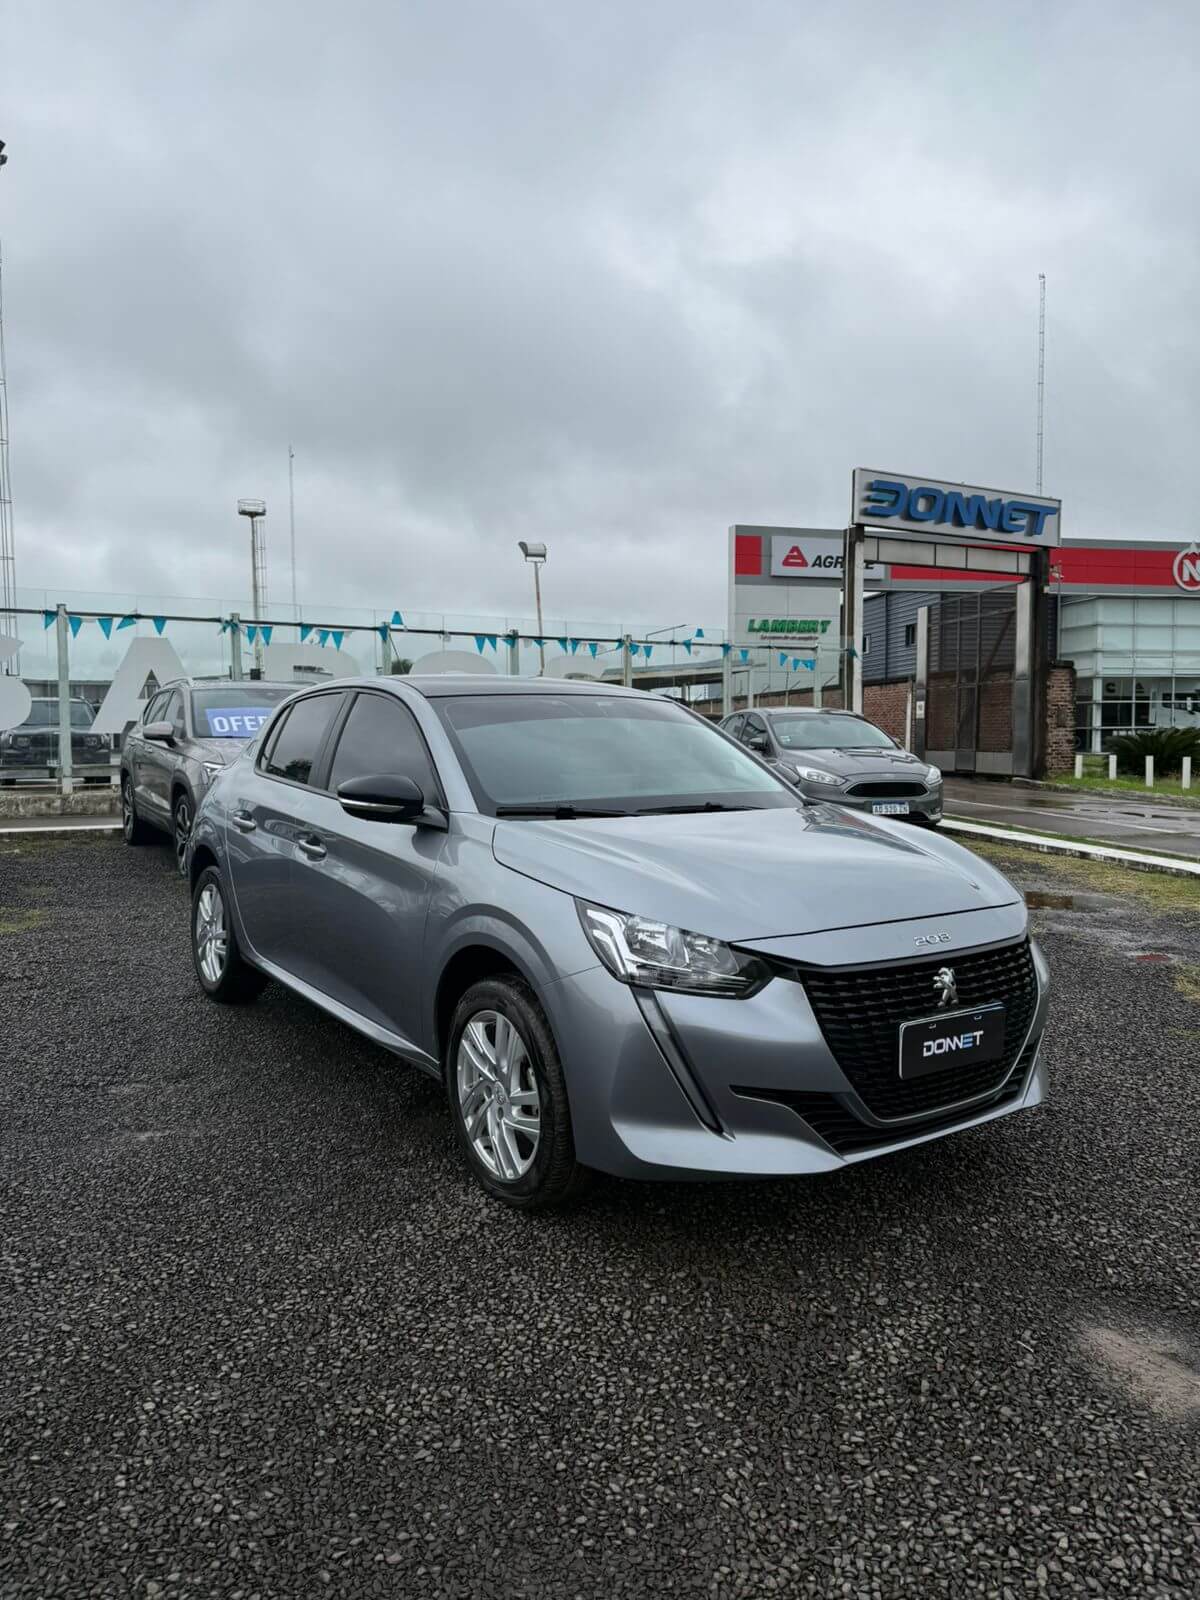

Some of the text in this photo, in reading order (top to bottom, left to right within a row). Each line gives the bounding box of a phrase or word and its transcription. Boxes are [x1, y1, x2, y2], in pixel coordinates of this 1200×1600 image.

[863, 479, 1059, 536] DONNET
[811, 555, 874, 570] AGRE
[747, 618, 832, 634] LAMBERT
[914, 932, 952, 947] 208
[922, 1030, 984, 1057] DONNET
